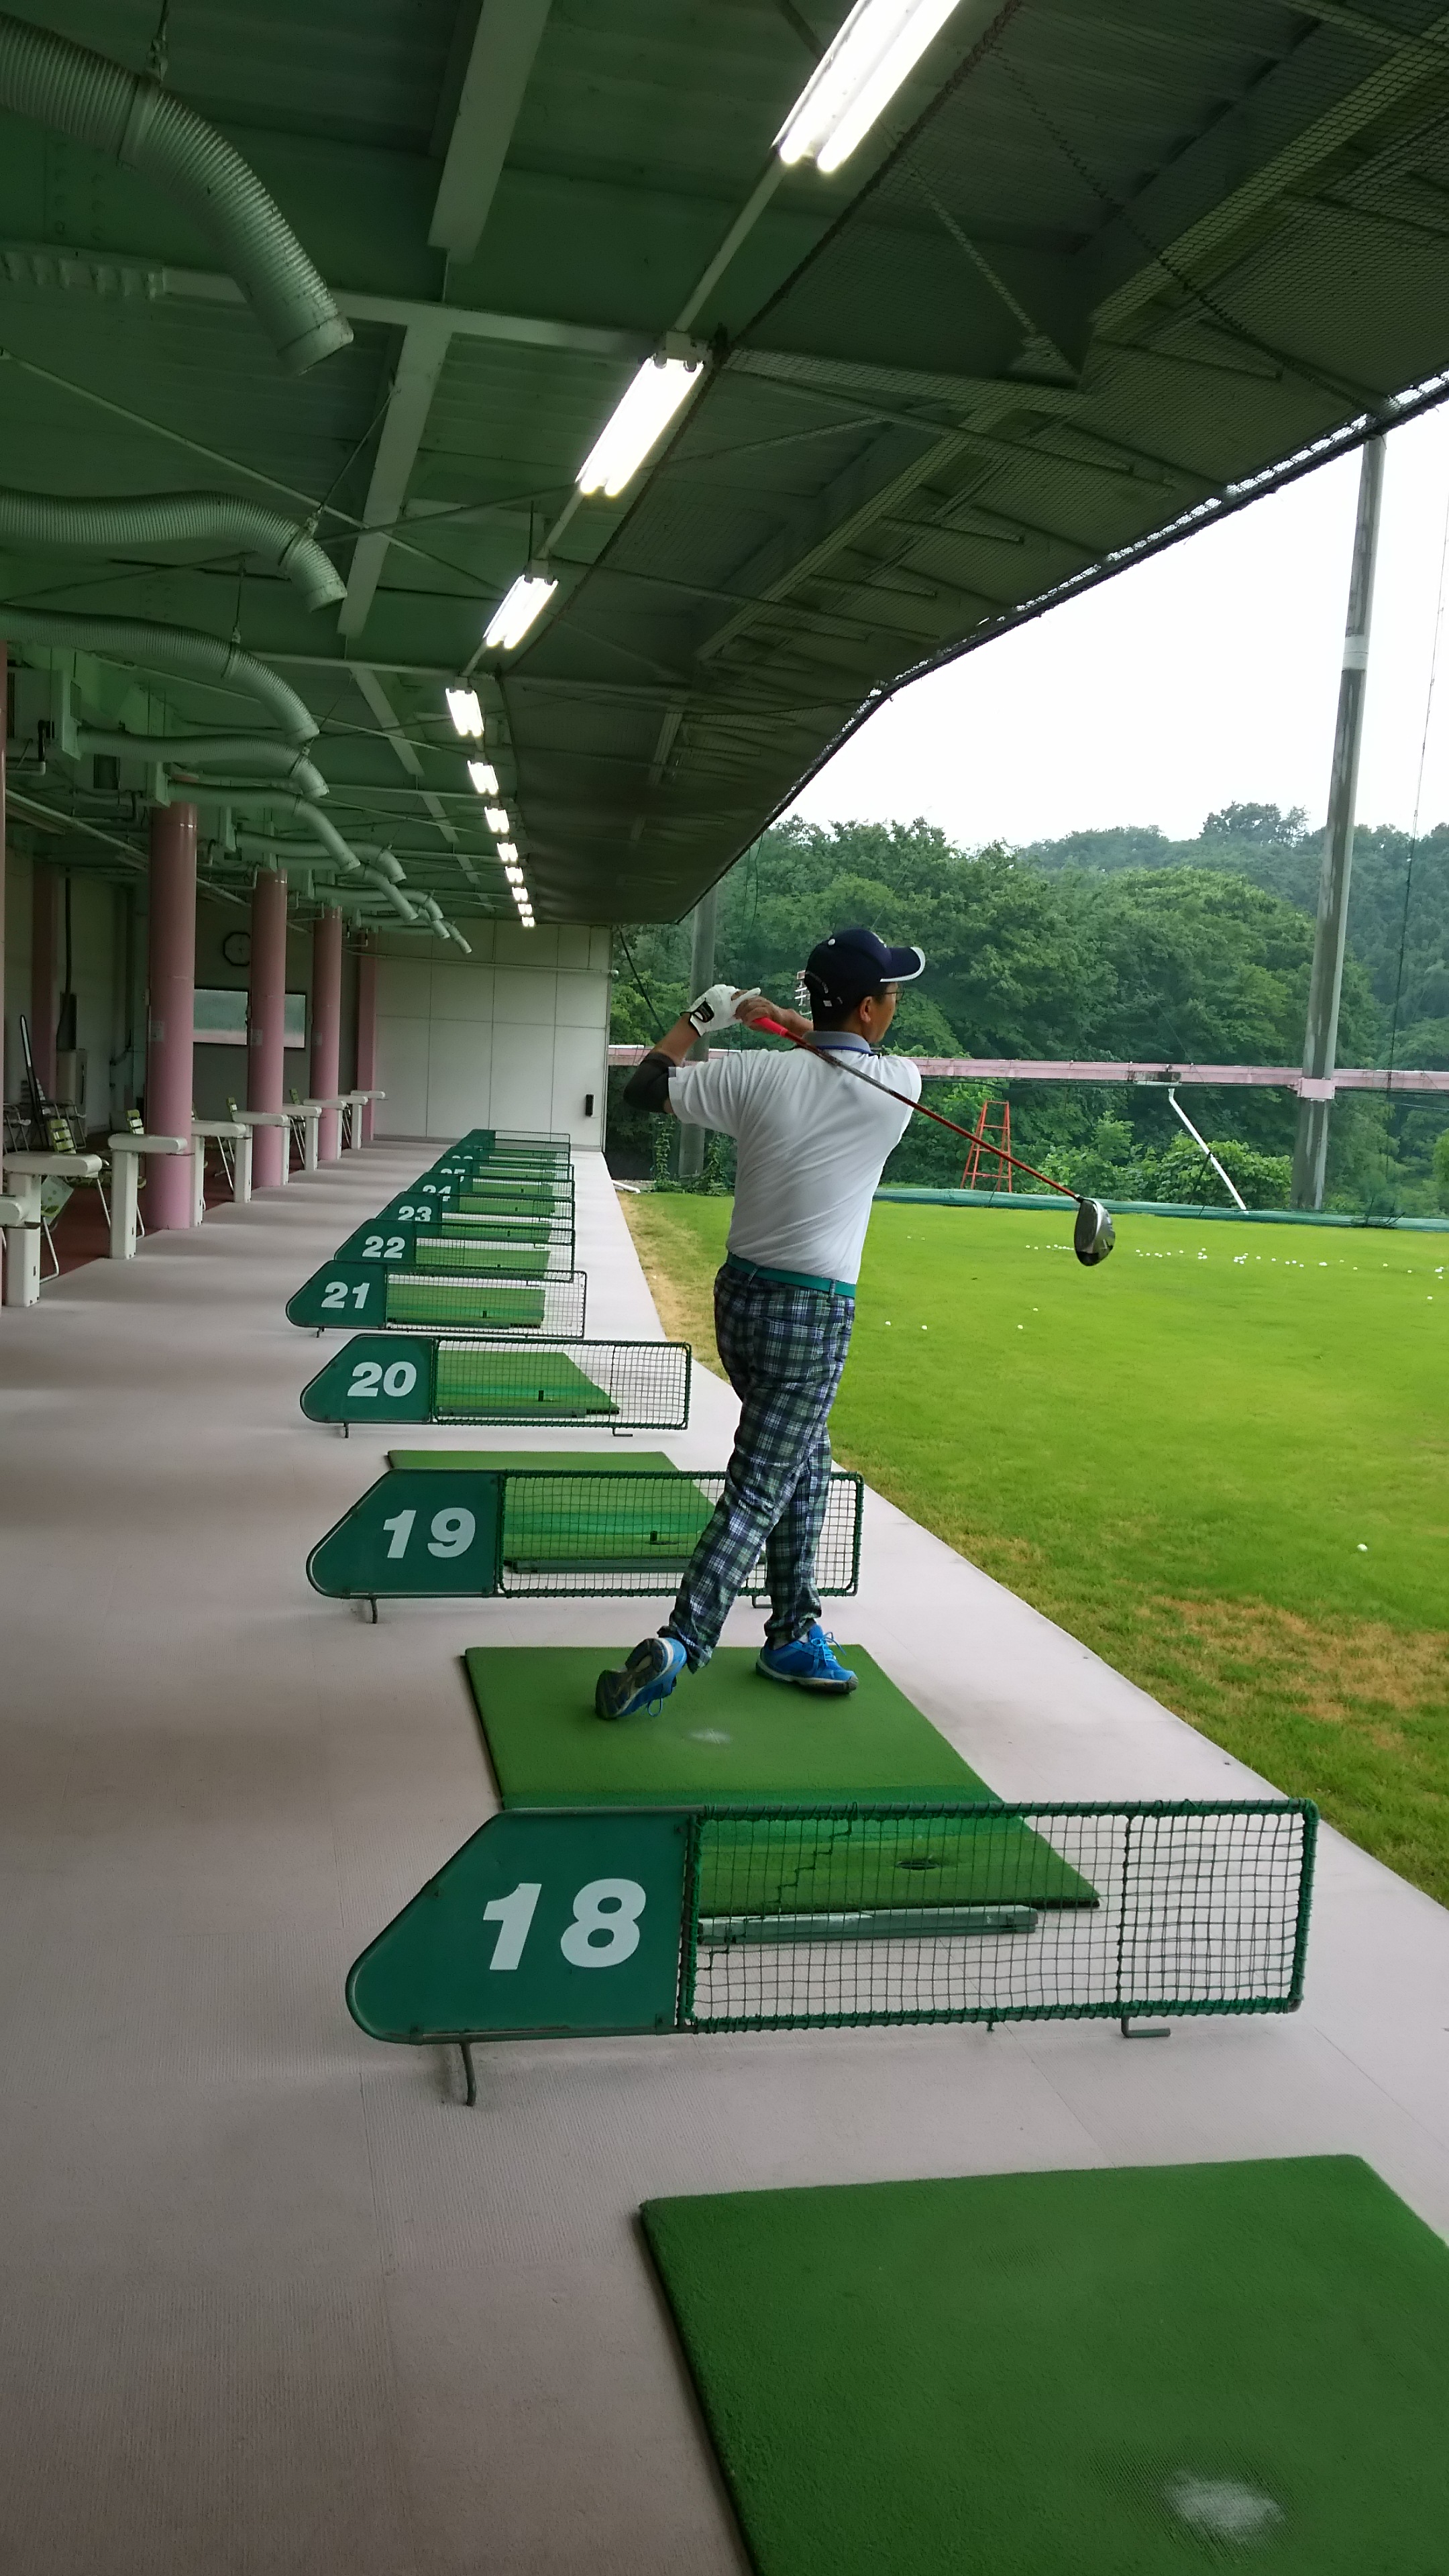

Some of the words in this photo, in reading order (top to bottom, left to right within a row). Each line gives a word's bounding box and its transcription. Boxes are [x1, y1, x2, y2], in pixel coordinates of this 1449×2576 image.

[398, 1205, 432, 1222] 23
[362, 1236, 405, 1258] 22
[321, 1281, 370, 1309] 21
[347, 1361, 417, 1397] 20
[383, 1507, 476, 1558] 19
[483, 1878, 647, 1970] 18
